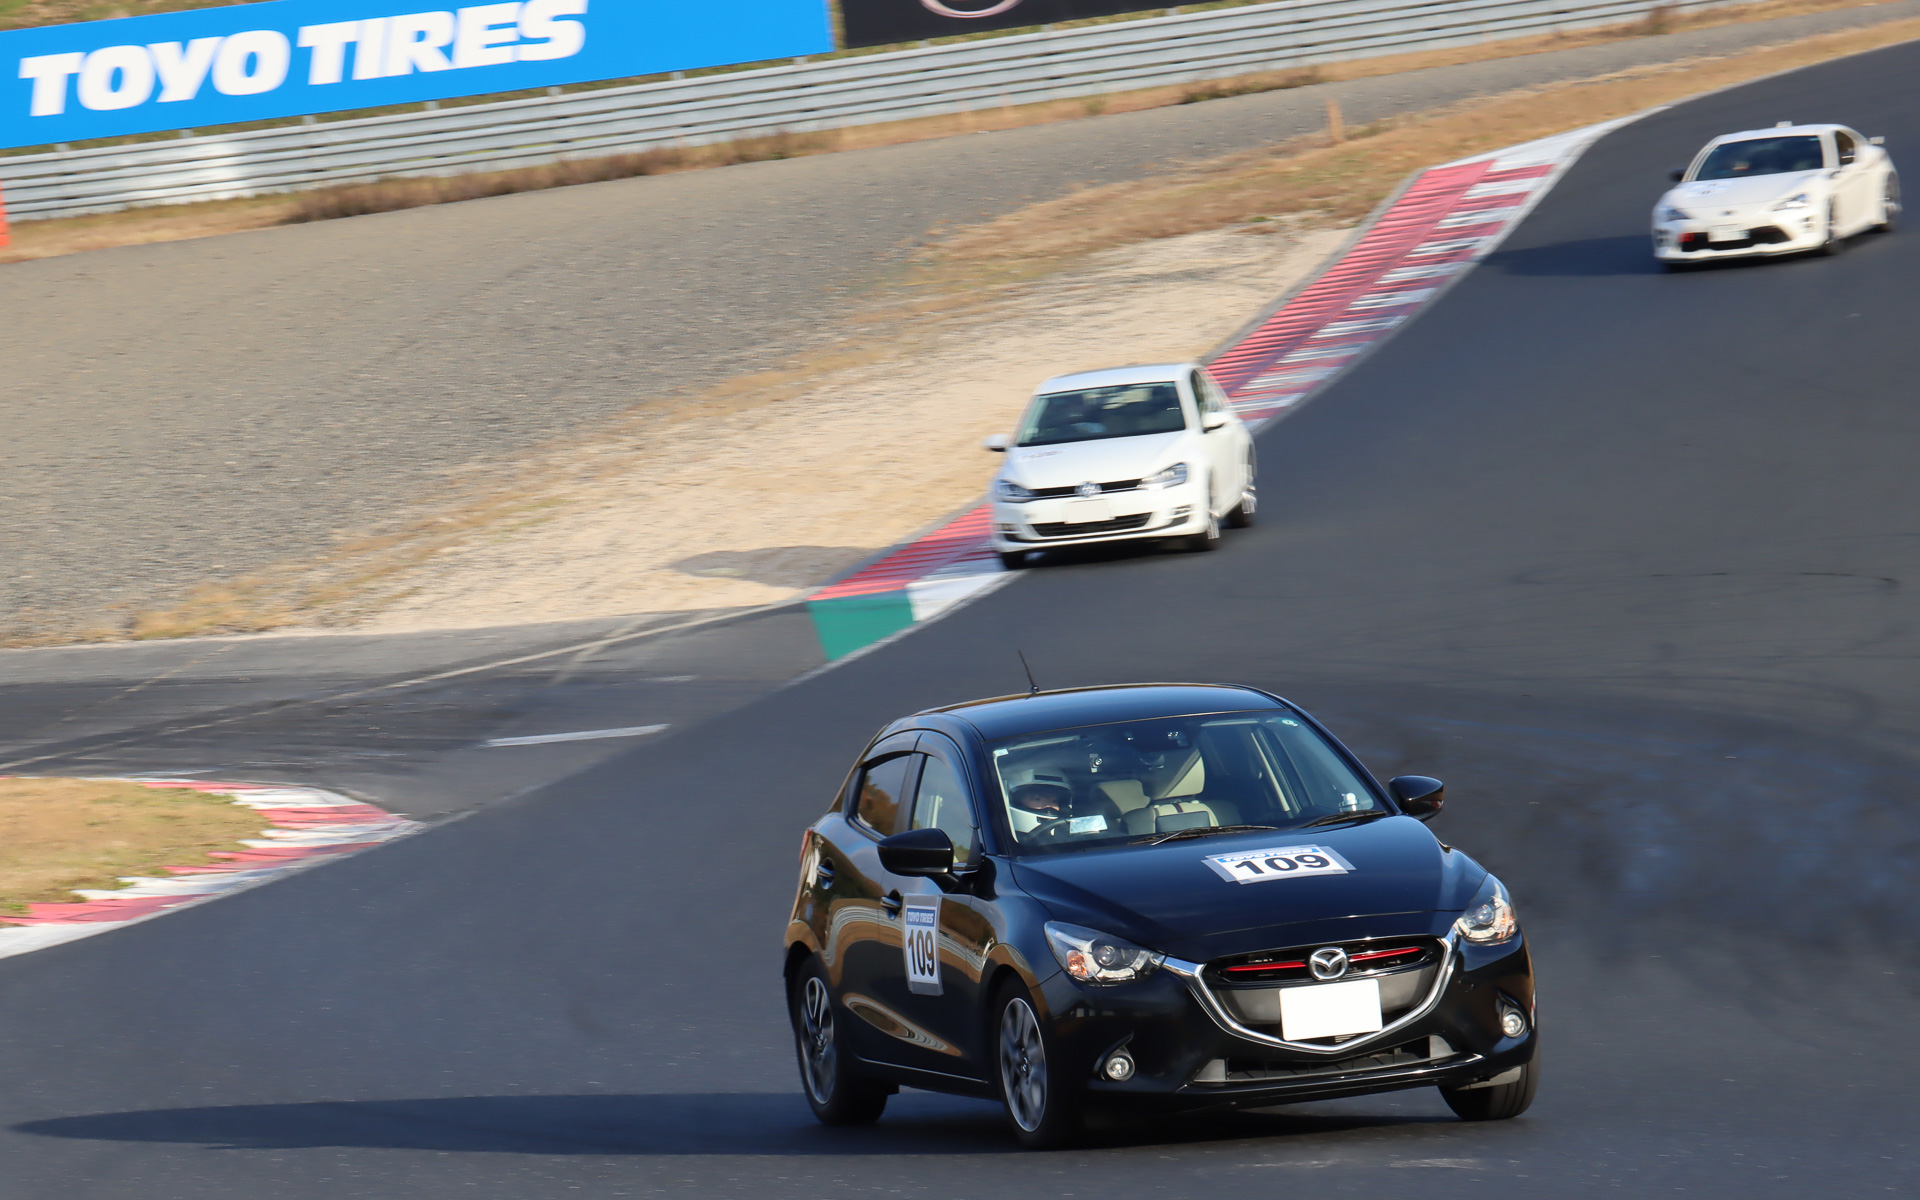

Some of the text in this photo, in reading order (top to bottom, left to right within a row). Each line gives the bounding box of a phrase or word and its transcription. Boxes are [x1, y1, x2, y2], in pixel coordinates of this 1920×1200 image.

[18, 0, 589, 117] TOYO TIRES
[1235, 854, 1330, 874] 109
[909, 930, 935, 977] 109
